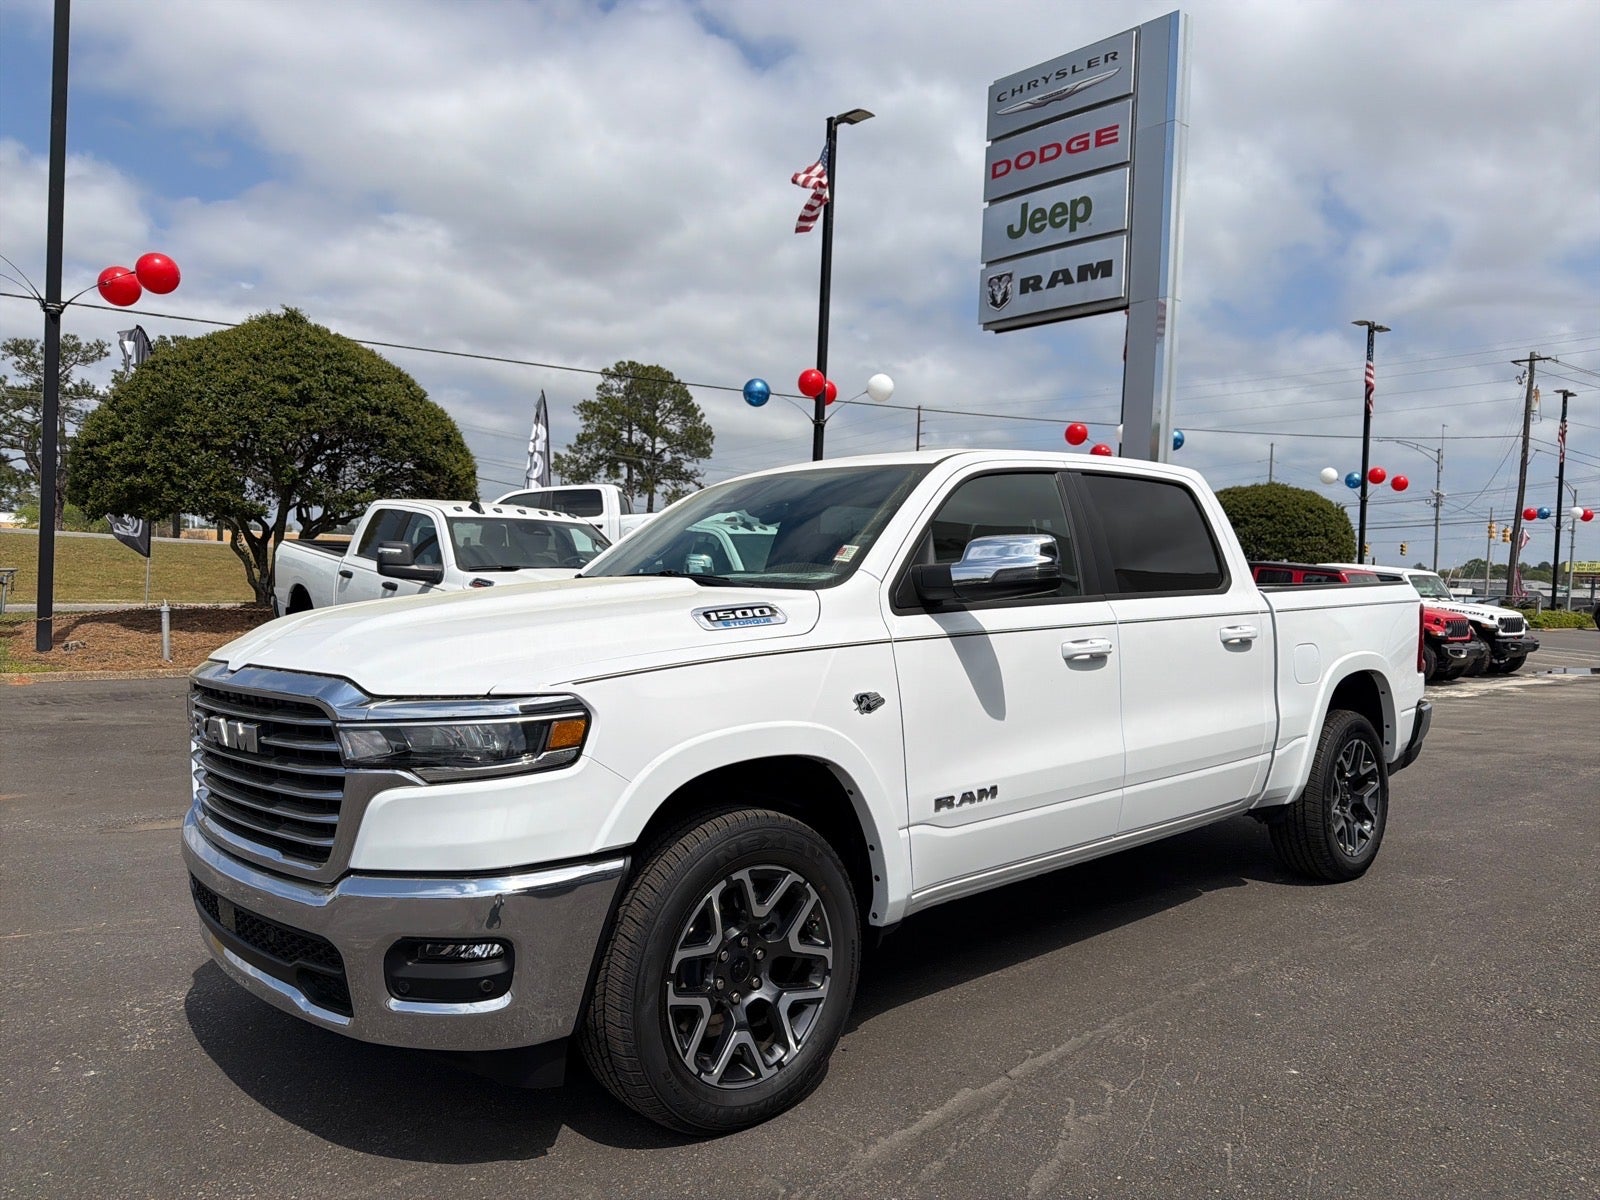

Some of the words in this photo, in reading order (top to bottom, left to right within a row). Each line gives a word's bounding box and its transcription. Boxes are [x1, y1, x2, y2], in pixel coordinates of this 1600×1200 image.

[996, 51, 1119, 103] CHRYSLER
[991, 124, 1120, 180] DODGE
[1007, 195, 1093, 240] Jeep
[1019, 259, 1113, 295] RAM
[706, 607, 772, 621] 1500
[192, 710, 257, 753] RAM
[934, 785, 998, 813] RAM
